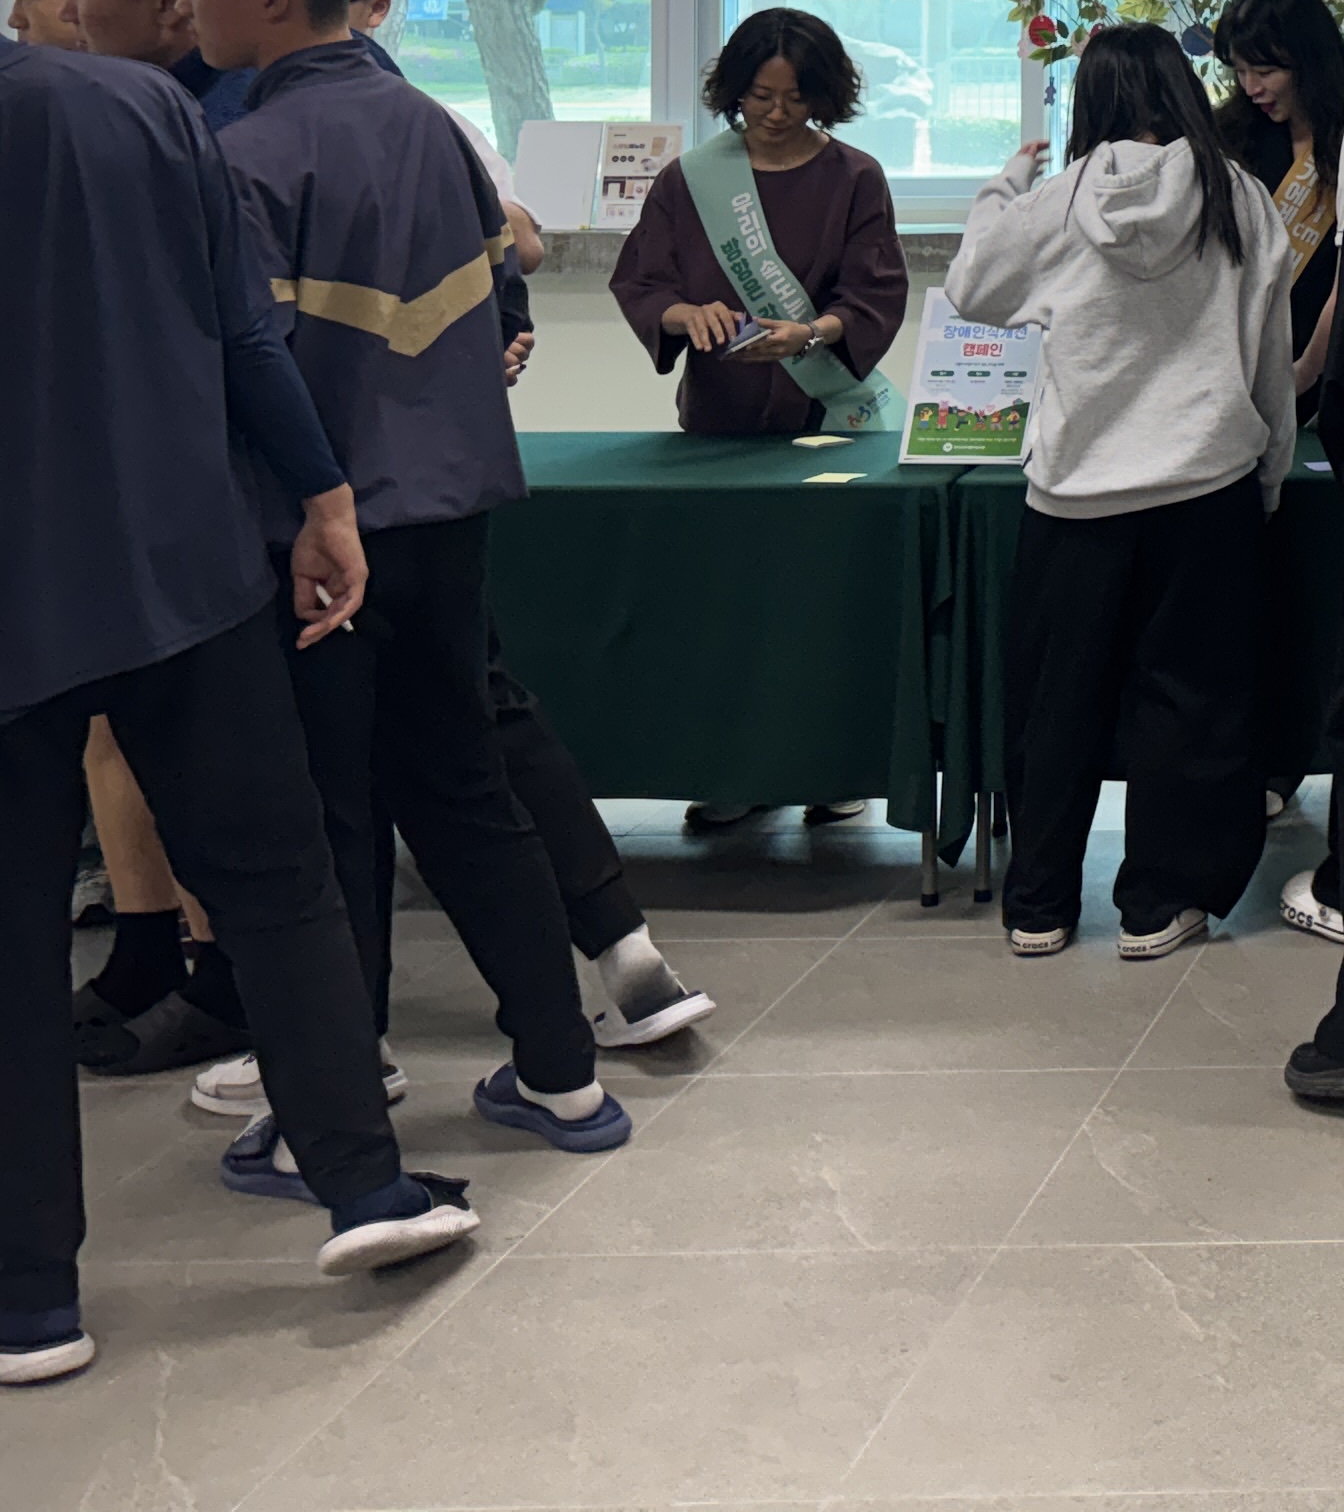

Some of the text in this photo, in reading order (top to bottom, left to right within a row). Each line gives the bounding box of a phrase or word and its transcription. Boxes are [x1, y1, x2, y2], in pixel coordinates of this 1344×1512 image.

[963, 343, 1003, 357] 캠페인
[1022, 941, 1049, 950] crocs
[1121, 945, 1148, 953] crocs
